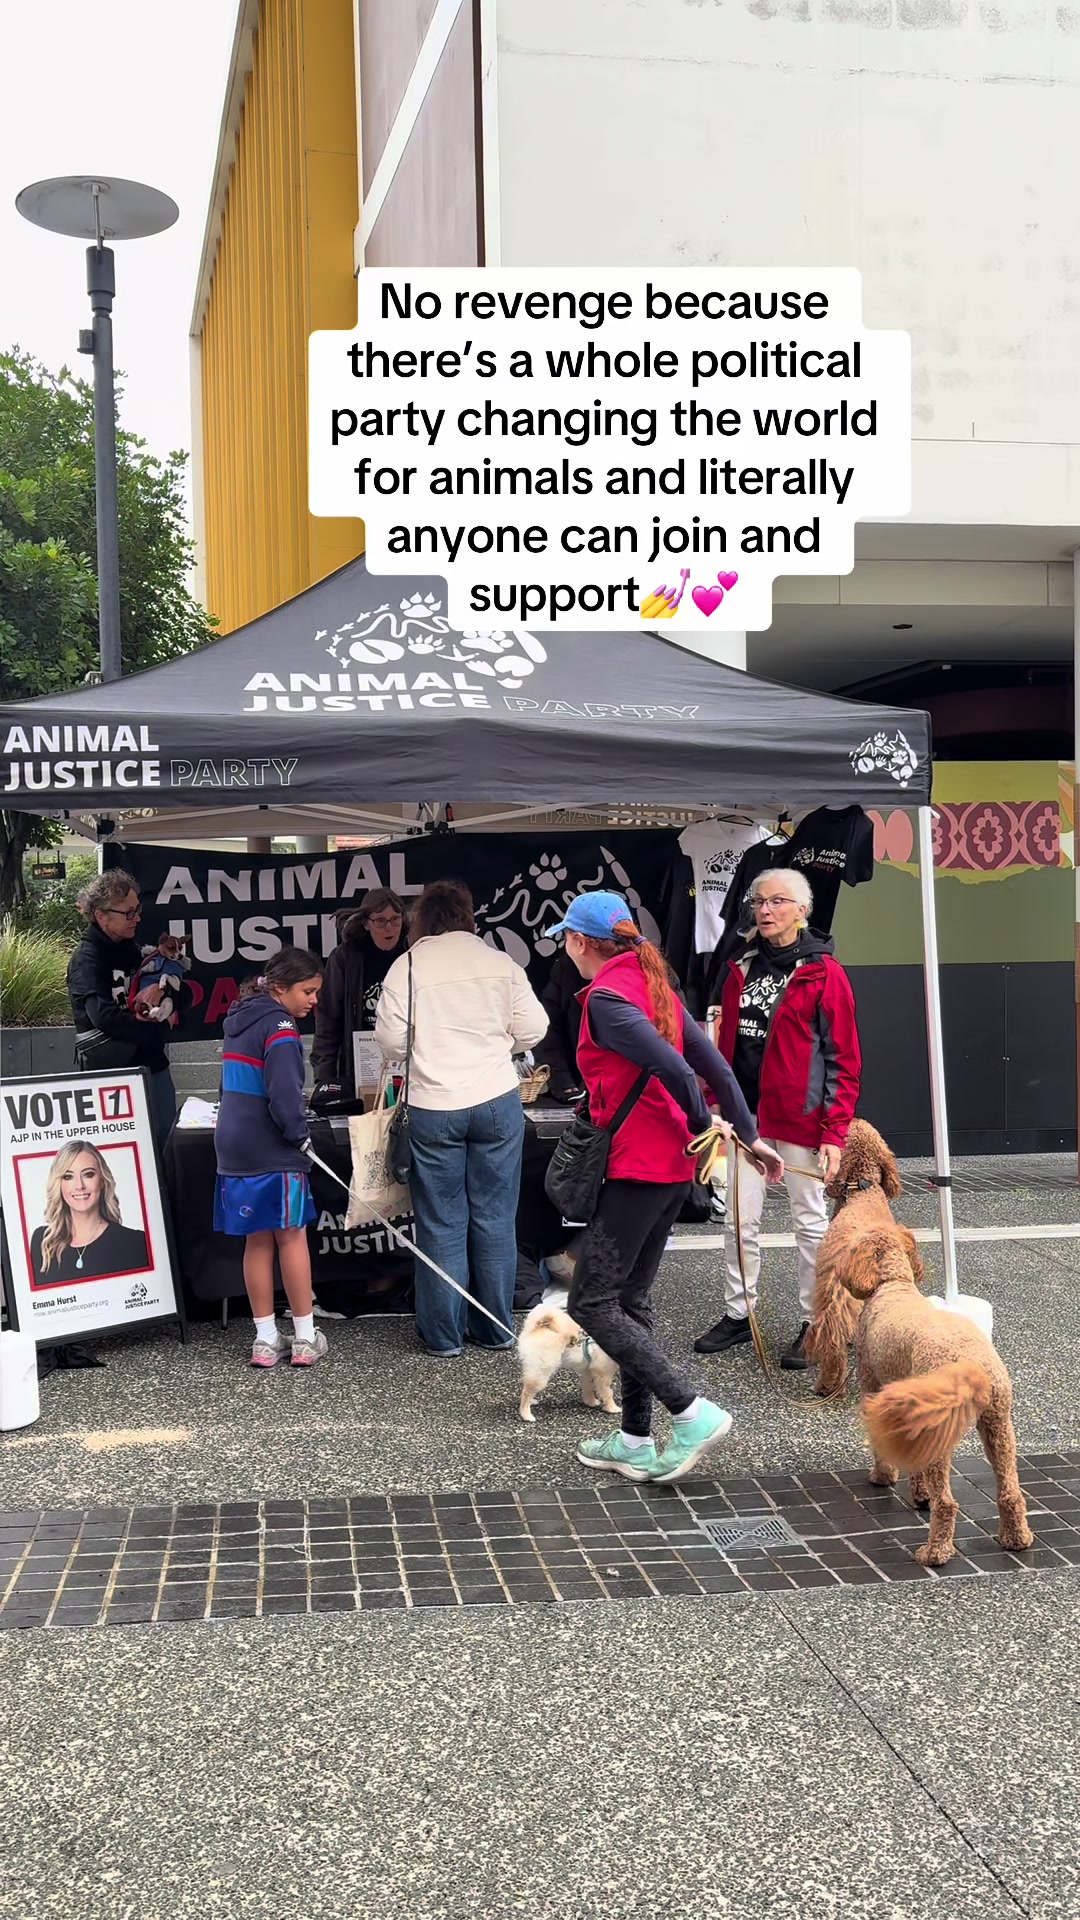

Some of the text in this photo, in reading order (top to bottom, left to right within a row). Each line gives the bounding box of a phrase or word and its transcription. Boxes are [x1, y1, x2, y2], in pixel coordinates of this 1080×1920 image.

[243, 672, 484, 692] ANIMAL
[243, 693, 700, 718] JUSTICE PARTY
[3, 725, 160, 753] ANIMAL
[4, 758, 299, 791] JUSTICE PARTY
[155, 852, 425, 905] ANIMAL
[701, 879, 728, 888] ANIMAL
[701, 885, 728, 893] JUSTICE
[168, 912, 338, 964] USTI
[4, 1088, 121, 1130] VOTE 1
[10, 1121, 136, 1144] AJP IN THE UPPER HOUSE
[32, 1294, 78, 1310] Emma Hurst
[124, 1298, 160, 1310] JUSTICE PARTY
